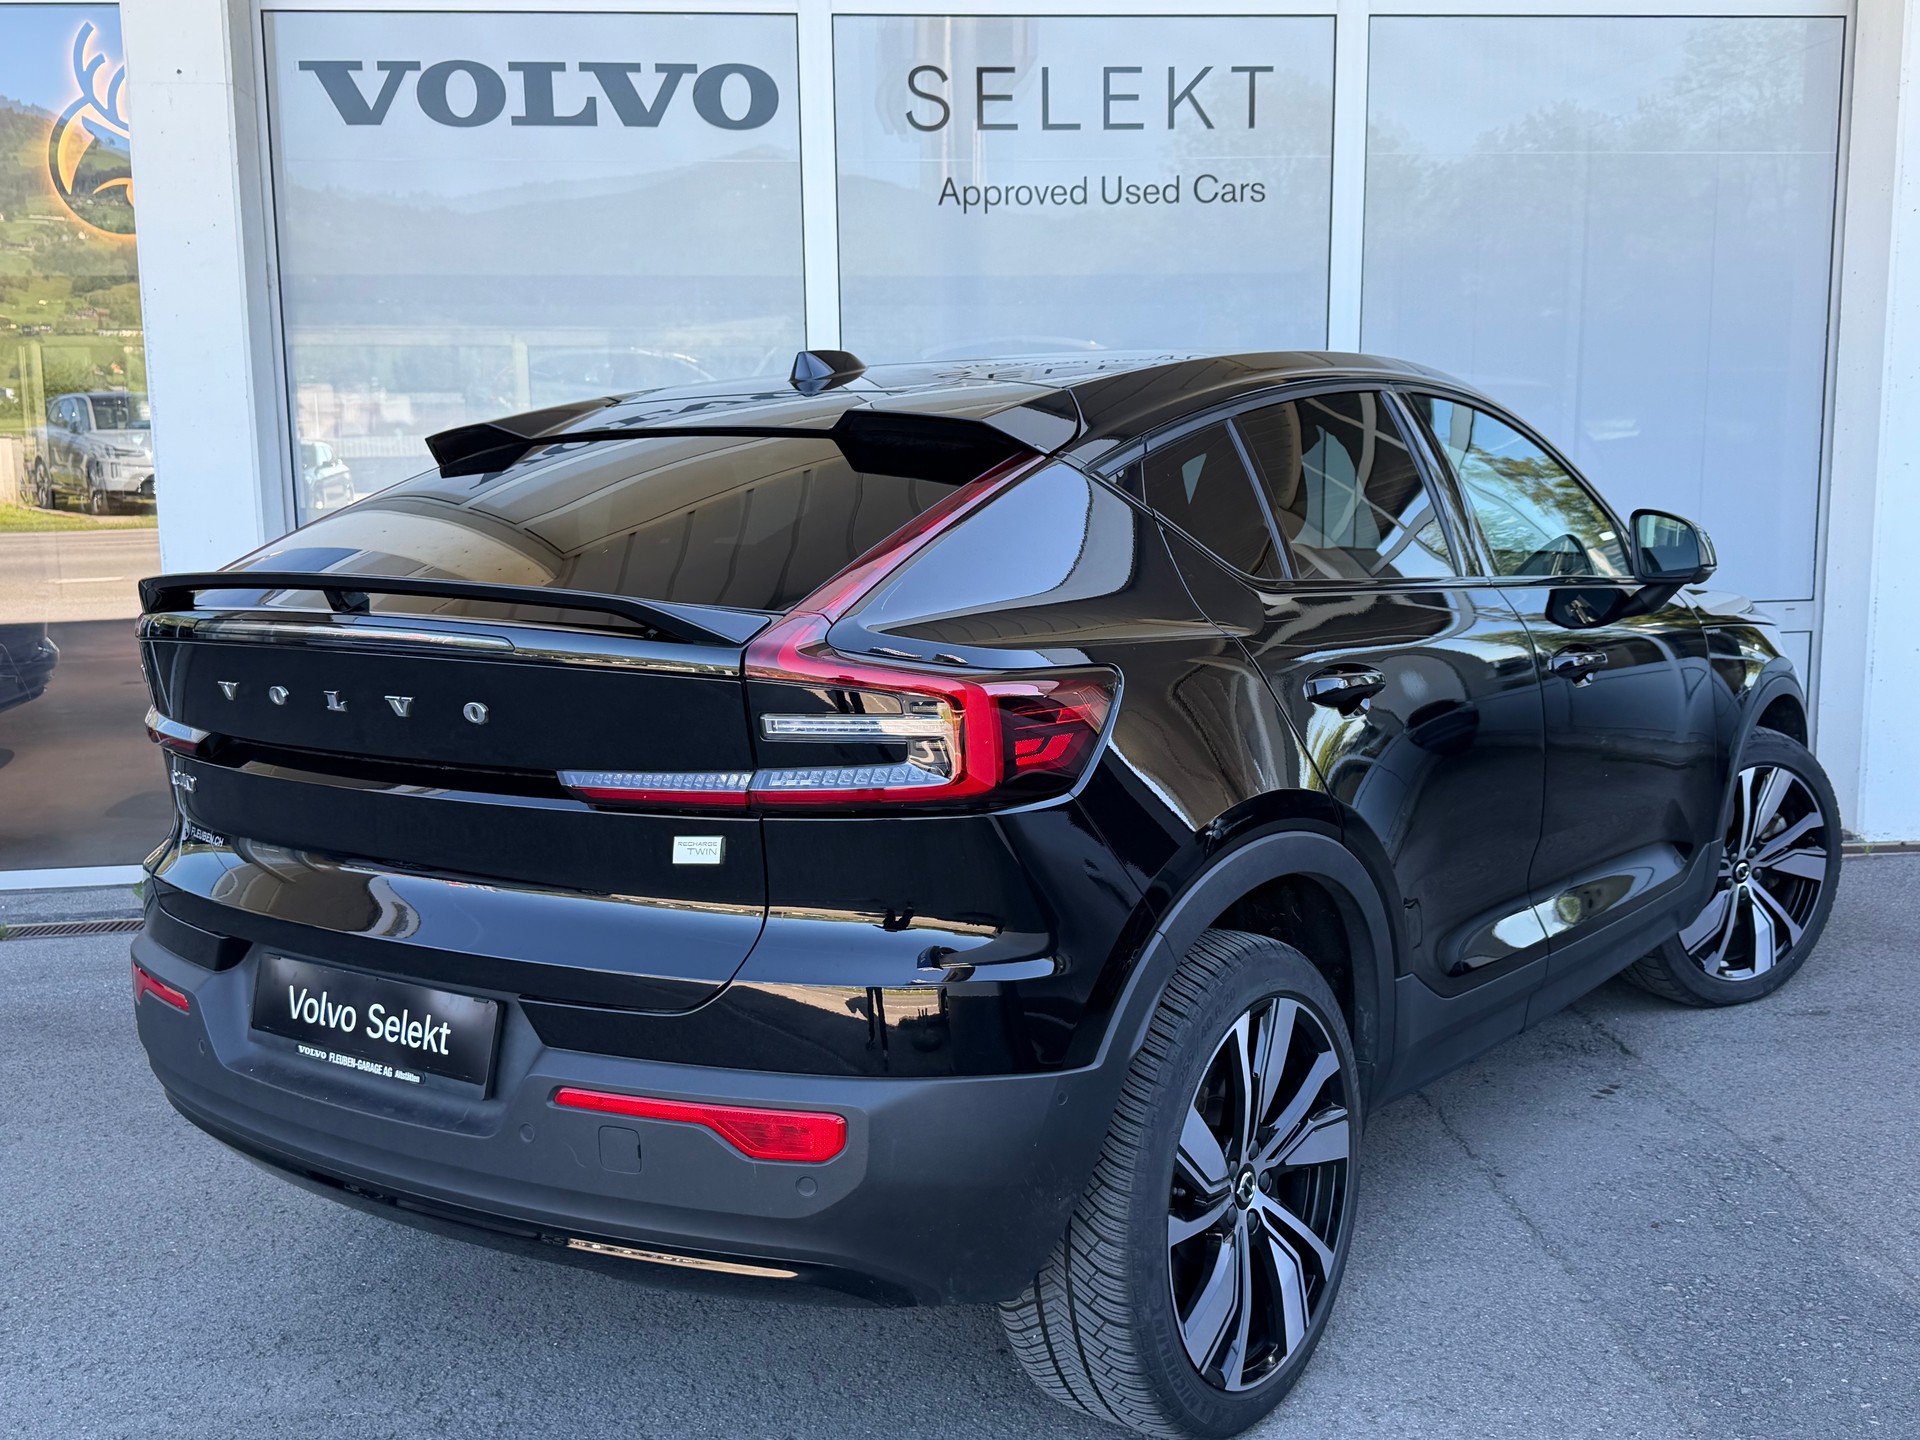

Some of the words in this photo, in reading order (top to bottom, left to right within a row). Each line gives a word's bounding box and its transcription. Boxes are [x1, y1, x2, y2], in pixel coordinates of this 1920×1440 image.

[299, 60, 779, 130] VOLVO
[905, 64, 1274, 132] SELEKT
[938, 176, 1088, 214] Approved
[1101, 175, 1180, 204] Used
[1193, 174, 1266, 203] Cars
[217, 680, 490, 725] VOLVO
[191, 826, 224, 847] FLEUBEN.CH
[686, 847, 718, 855] TWIN
[288, 984, 357, 1033] Volvo
[366, 1003, 451, 1055] Selekt
[298, 1045, 327, 1059] VOLVO
[328, 1052, 383, 1075] FLEUBEN-GARAGE
[383, 1066, 393, 1077] AG
